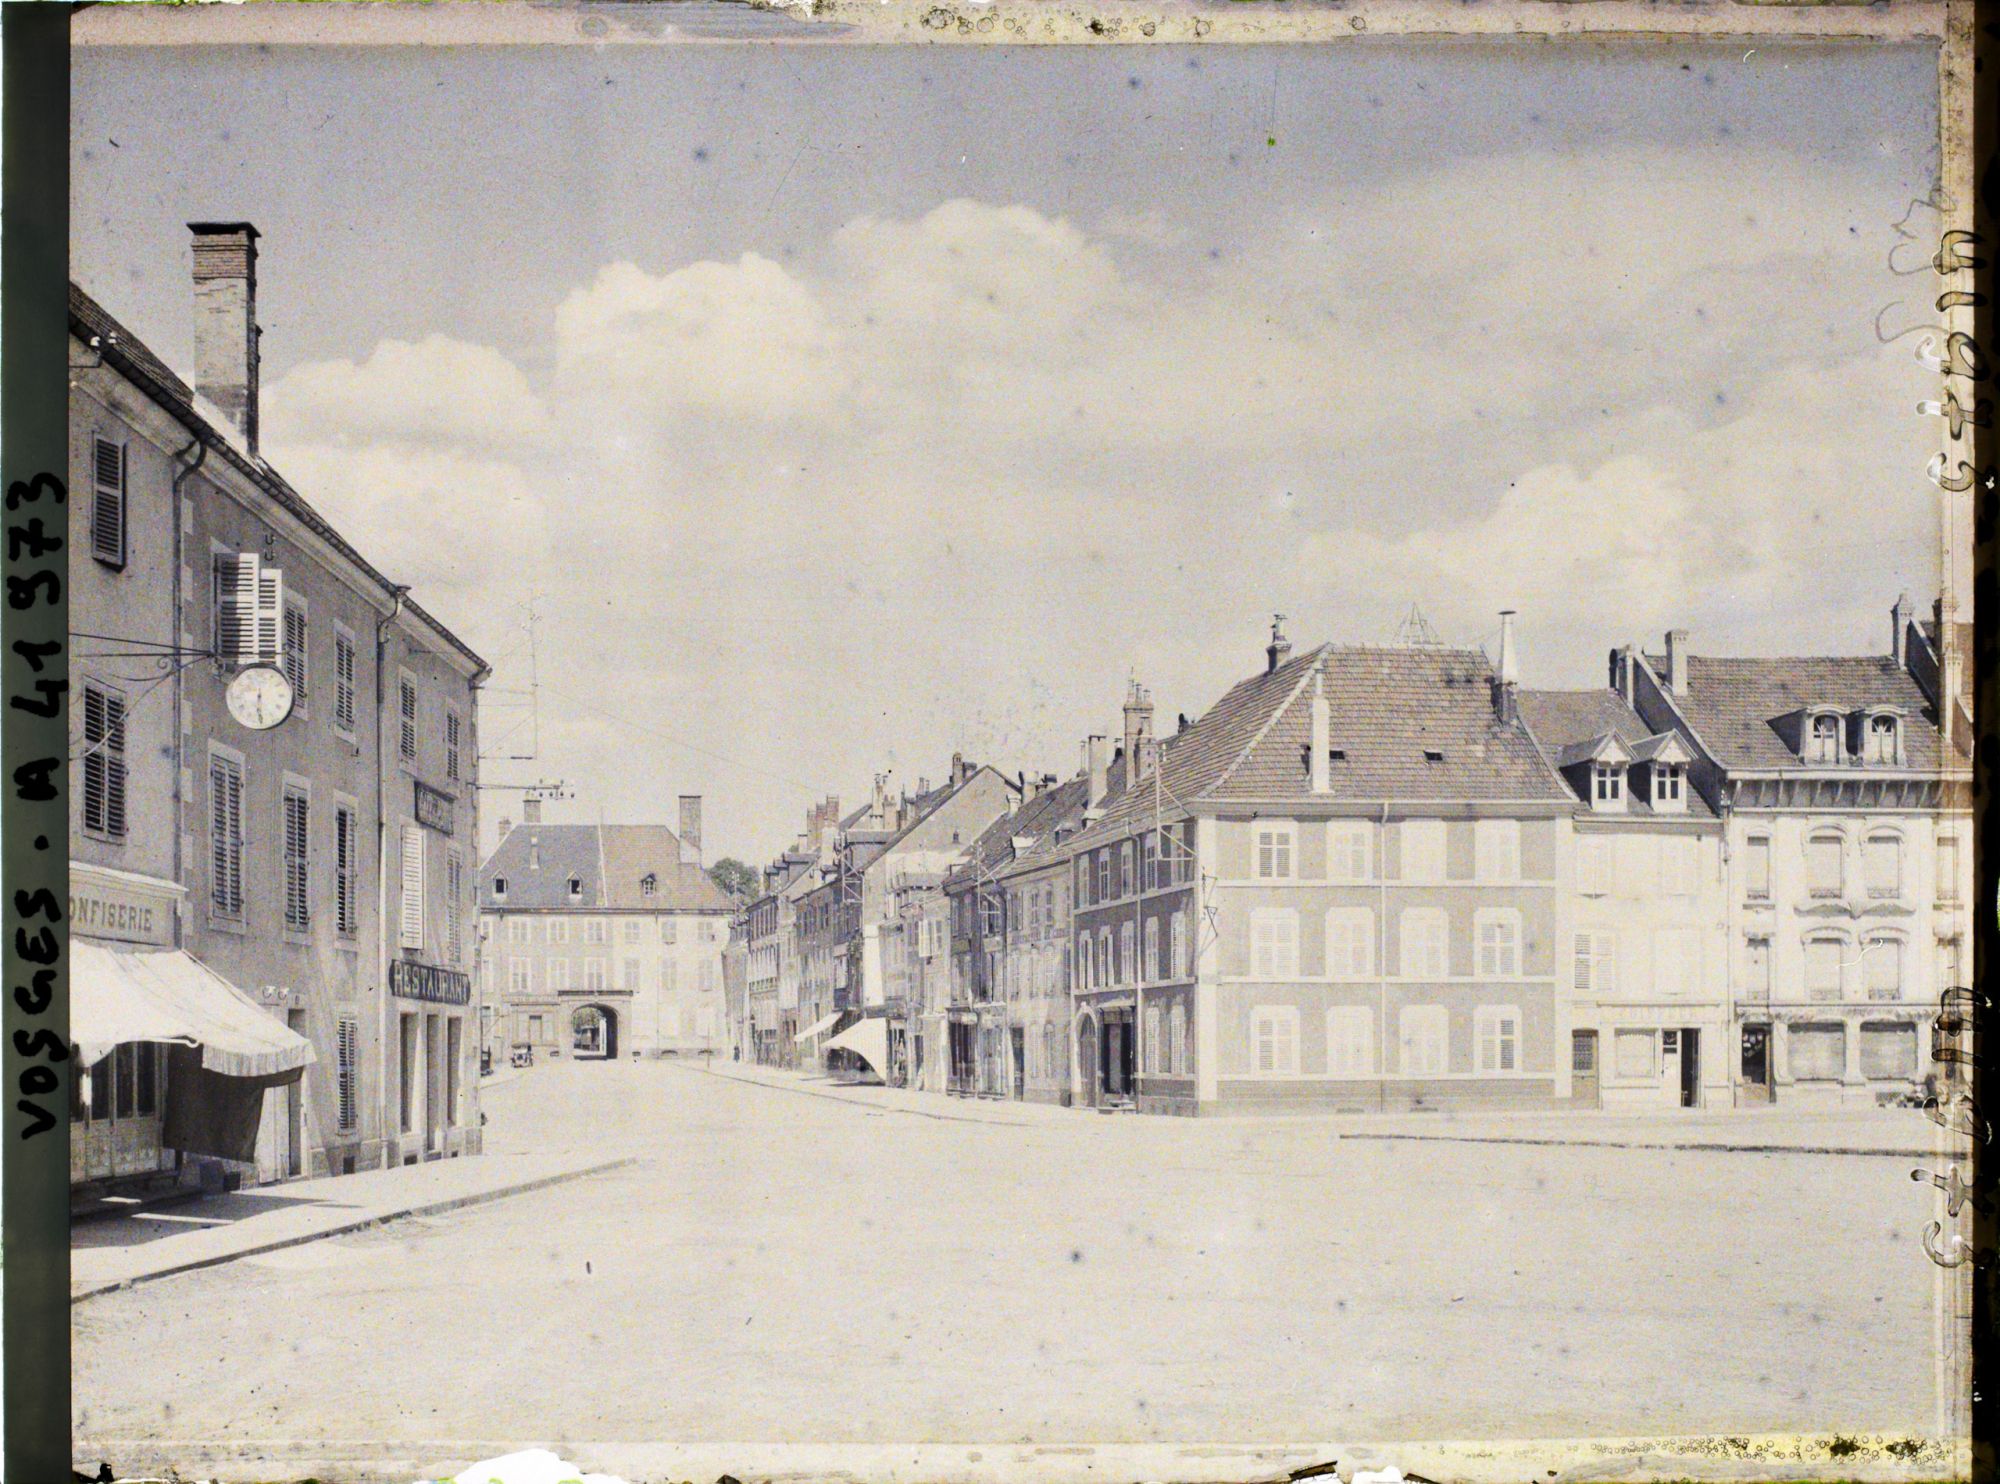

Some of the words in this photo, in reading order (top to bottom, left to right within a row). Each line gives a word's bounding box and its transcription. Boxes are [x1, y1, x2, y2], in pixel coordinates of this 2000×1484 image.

[6, 472, 68, 718] 41973
[13, 757, 60, 801] A
[13, 888, 68, 1140] VOSGES
[394, 961, 468, 1004] RESTAURANT
